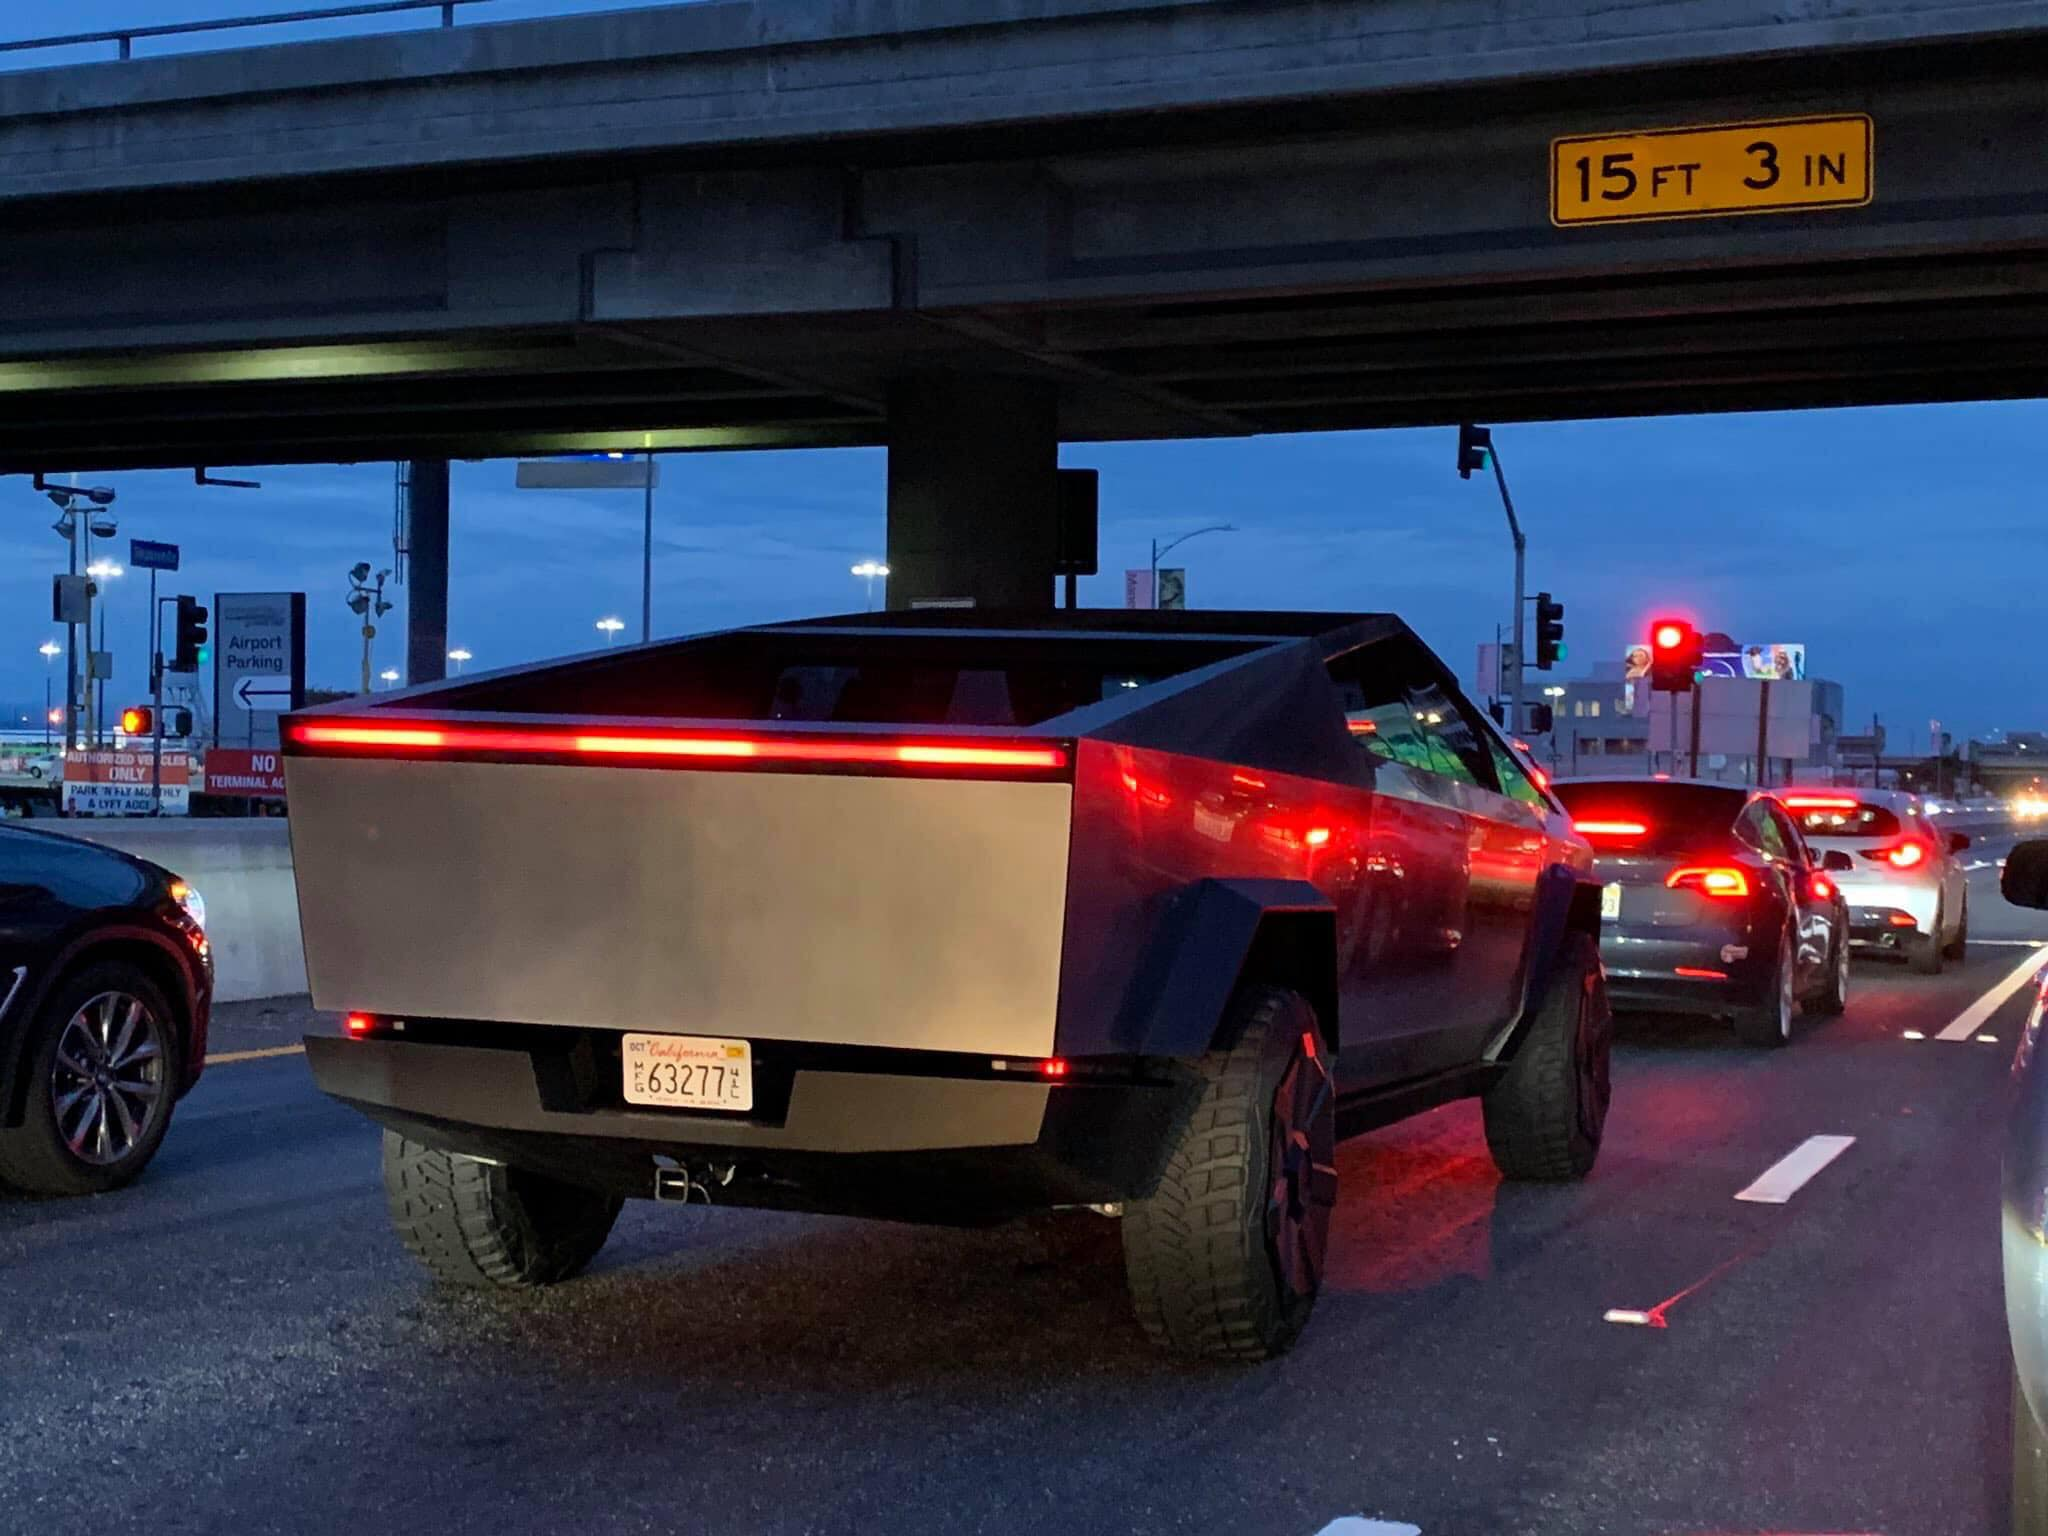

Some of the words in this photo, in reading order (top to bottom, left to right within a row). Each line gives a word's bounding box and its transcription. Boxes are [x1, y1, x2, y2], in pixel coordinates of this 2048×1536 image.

[1575, 152, 1638, 202] 15
[1651, 162, 1702, 197] FT
[1743, 141, 1781, 190] 3
[1804, 153, 1846, 187] IN
[229, 635, 282, 652] Airport
[227, 654, 283, 673] Parking
[251, 754, 276, 773] NO
[108, 767, 145, 781] ONLY
[209, 775, 268, 789] TERMINAL
[71, 783, 98, 797] PARK
[114, 786, 132, 797] FLY
[650, 1041, 719, 1063] California
[648, 1062, 725, 1097] 63277
